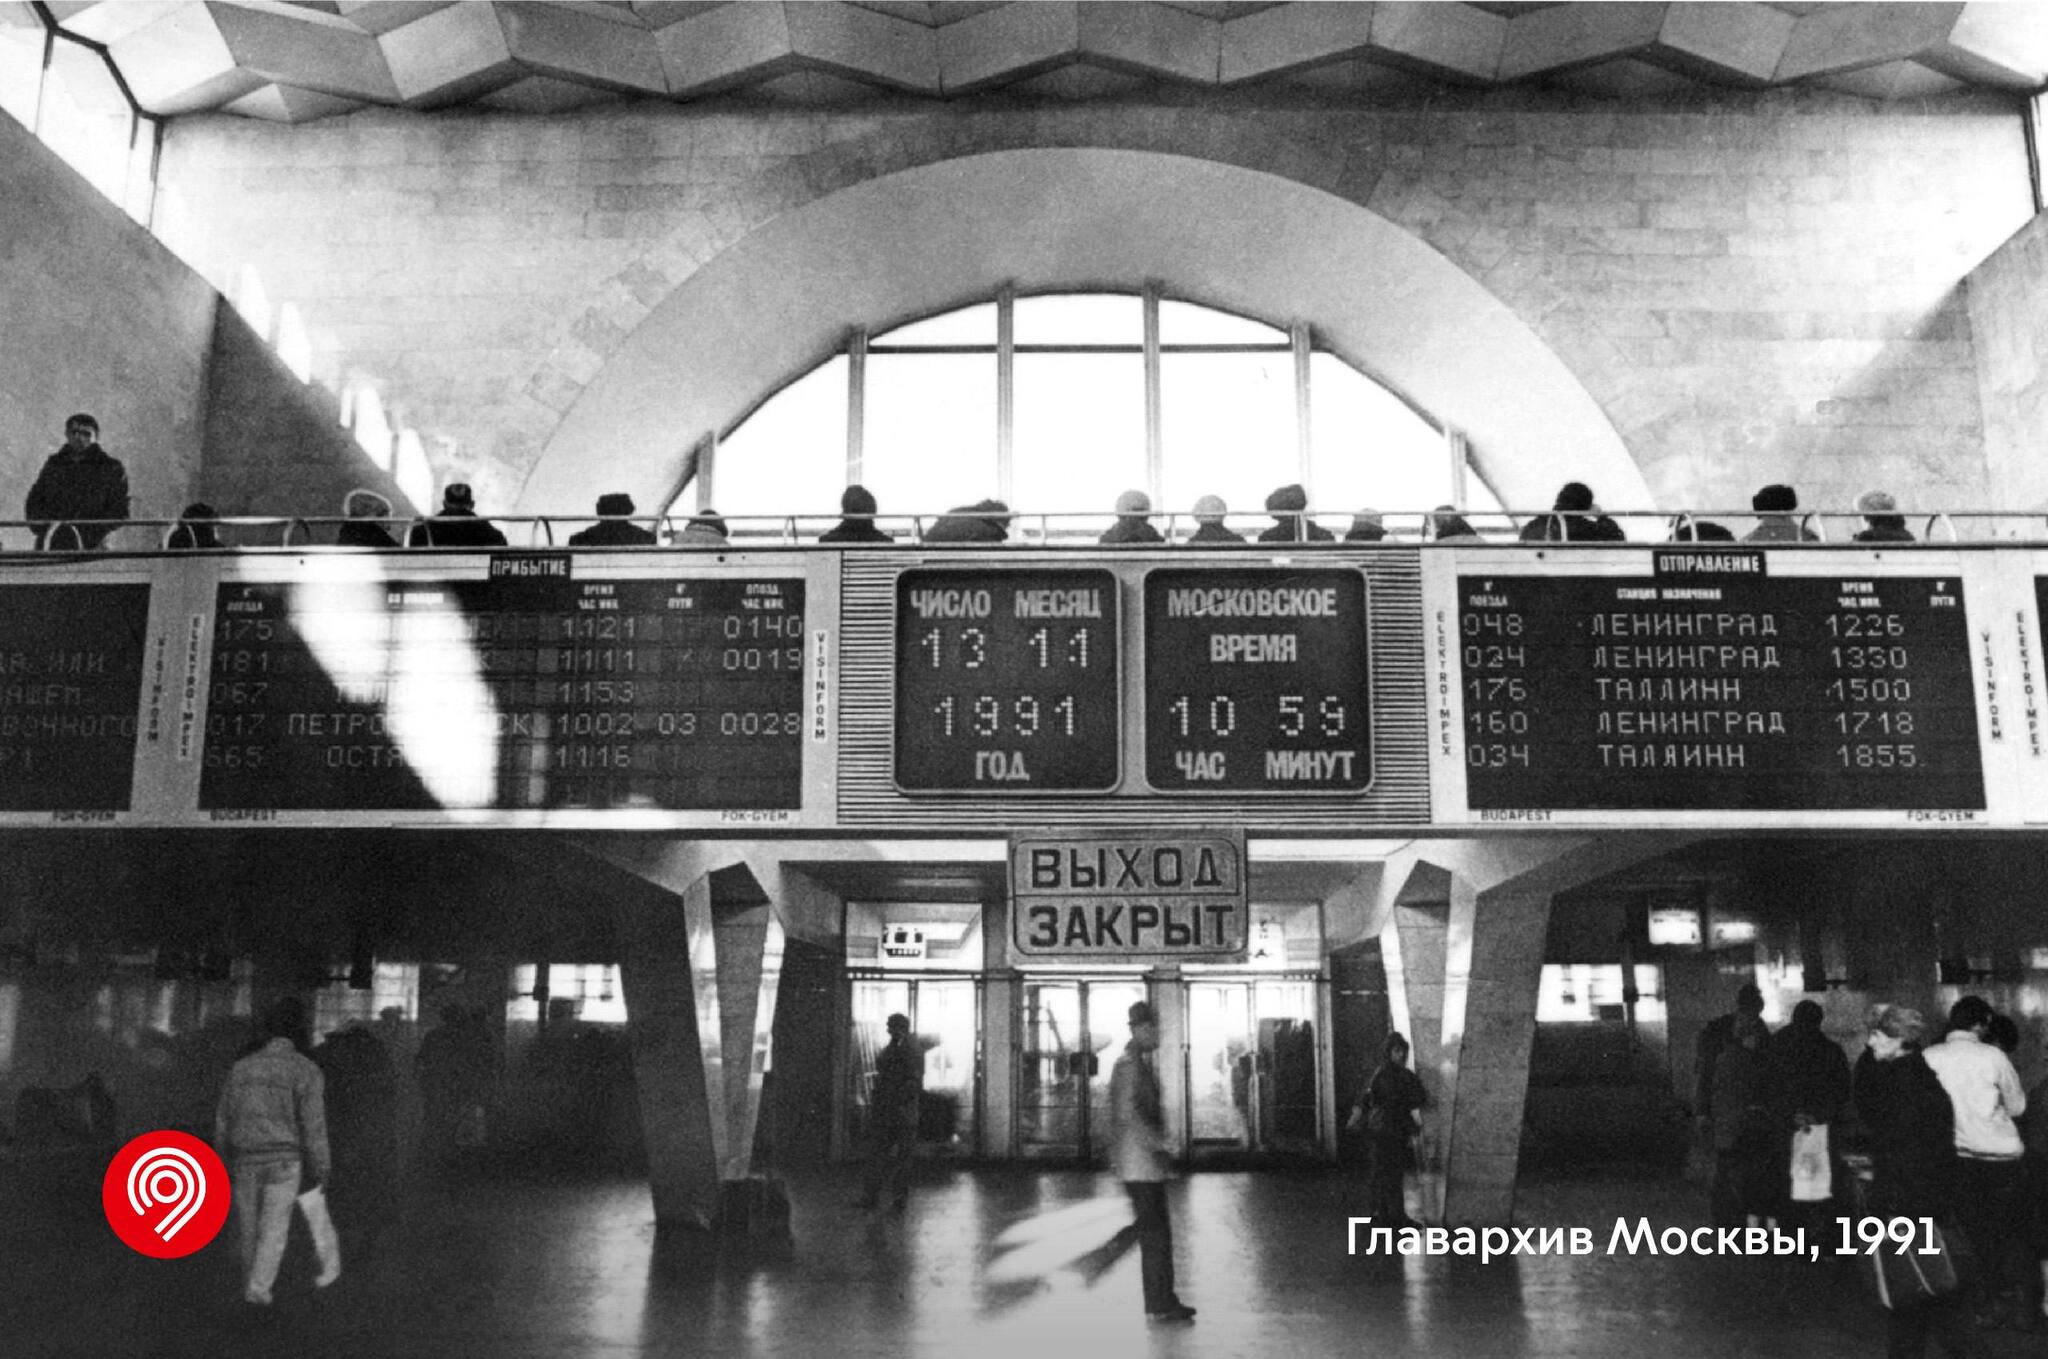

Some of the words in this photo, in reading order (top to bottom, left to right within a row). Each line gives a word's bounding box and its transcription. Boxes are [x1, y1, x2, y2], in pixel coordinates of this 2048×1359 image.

[491, 559, 567, 577] ПРИБЫТИЕ
[1659, 554, 1760, 573] ОТПРАВЛЕНИЕ
[911, 590, 991, 617] ЧИСЛО
[1015, 590, 1102, 619] МЕСЯЦ
[1167, 588, 1338, 617] МОСКОВСКОЕ
[220, 619, 274, 641] 175
[723, 616, 802, 639] 0140
[1463, 613, 1523, 636] 048
[1591, 613, 1778, 637] ЛЕНИНГРАД
[1825, 614, 1905, 637] 1226
[559, 648, 636, 671] 1111
[722, 648, 802, 671] 0019
[921, 628, 985, 668] 13
[1029, 628, 1088, 668] 11
[1209, 634, 1297, 663] ВРЕМЯ
[1464, 646, 1526, 669] 024
[1592, 646, 1781, 670] ЛЕНИНГРАД
[1831, 646, 1908, 669] 1330
[558, 679, 635, 703] 1153
[815, 632, 827, 740] VISINFORM
[1437, 610, 1450, 757] ELEKTROIMPEX
[1468, 677, 1527, 701] 176
[1595, 678, 1741, 701] ТАЛЛИНН
[1829, 678, 1911, 701] 1500
[1982, 630, 2002, 741] VISINFORM
[2016, 611, 2041, 757] ELEKTROIMPEX
[556, 712, 635, 736] 1002
[657, 712, 696, 736] 03
[720, 712, 801, 736] 0028
[933, 696, 1075, 737] 1991
[1169, 696, 1236, 737] 10
[1278, 696, 1346, 737] 59
[1469, 711, 1529, 734] 160
[1597, 711, 1786, 735] ЛЕНИНГРАД
[1834, 711, 1915, 735] 1718
[555, 744, 631, 768] 1116
[975, 752, 1030, 781] ГОД
[1175, 751, 1227, 781] ЧАС
[1265, 751, 1356, 781] МИНУТ
[1467, 744, 1530, 767] 034
[1836, 744, 1918, 768] 1855
[721, 810, 789, 822] FOK-GYEM
[1480, 810, 1553, 822] BUDAPEST
[1906, 810, 1975, 822] FOK-GYEM
[1030, 847, 1223, 889] ВЫХОД
[1028, 905, 1235, 948] ЗАКРЫТ
